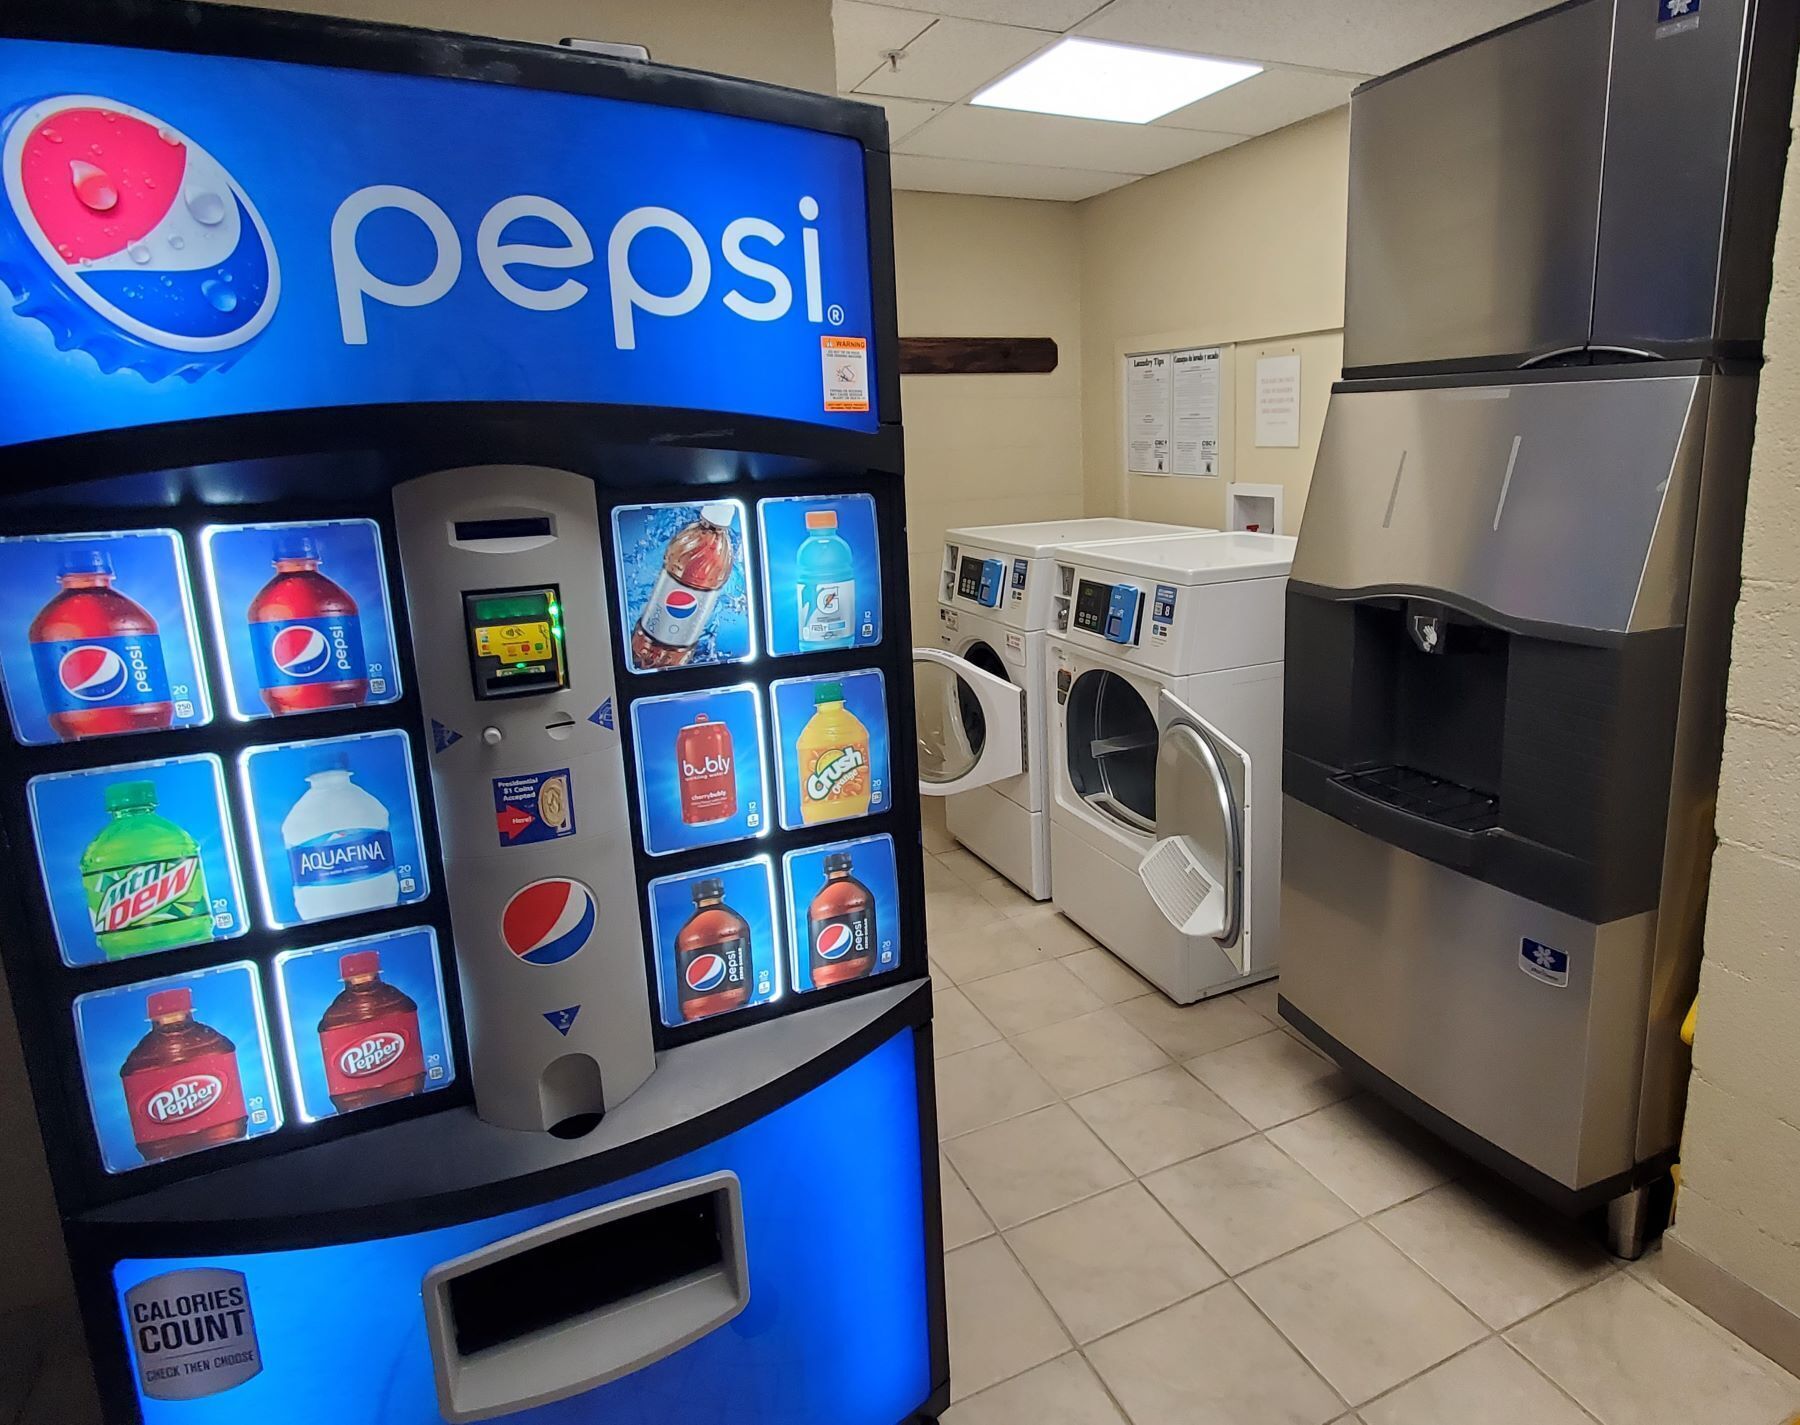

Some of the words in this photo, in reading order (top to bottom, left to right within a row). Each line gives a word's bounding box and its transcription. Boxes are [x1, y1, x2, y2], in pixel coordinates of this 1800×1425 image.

[330, 184, 823, 350] pepsi
[836, 340, 865, 348] WARNING
[1164, 605, 1171, 617] 8
[328, 625, 352, 670] pepsi
[125, 645, 152, 692] pepsi
[368, 663, 383, 672] 20
[172, 684, 189, 695] 20
[497, 777, 539, 788] Presidential
[807, 746, 865, 800] Crush
[503, 791, 536, 801] Accepted
[513, 785, 534, 793] Coins
[300, 840, 386, 875] AQUAFINA
[398, 864, 412, 874] 20
[211, 898, 228, 909] 20
[853, 920, 864, 951] pepsi
[725, 950, 739, 982] pepsi
[758, 970, 769, 978] 20
[361, 1038, 385, 1056] Dr
[347, 1039, 399, 1075] Pepper
[427, 1053, 440, 1063] 20
[171, 1081, 199, 1102] Dr
[155, 1082, 216, 1121] Pepper
[248, 1096, 263, 1108] 20
[133, 1286, 244, 1324] CALORIES
[138, 1309, 246, 1354] COUNT
[145, 1365, 181, 1382] CHECK
[183, 1359, 211, 1375] THEN
[213, 1350, 255, 1369] CHOOSE
